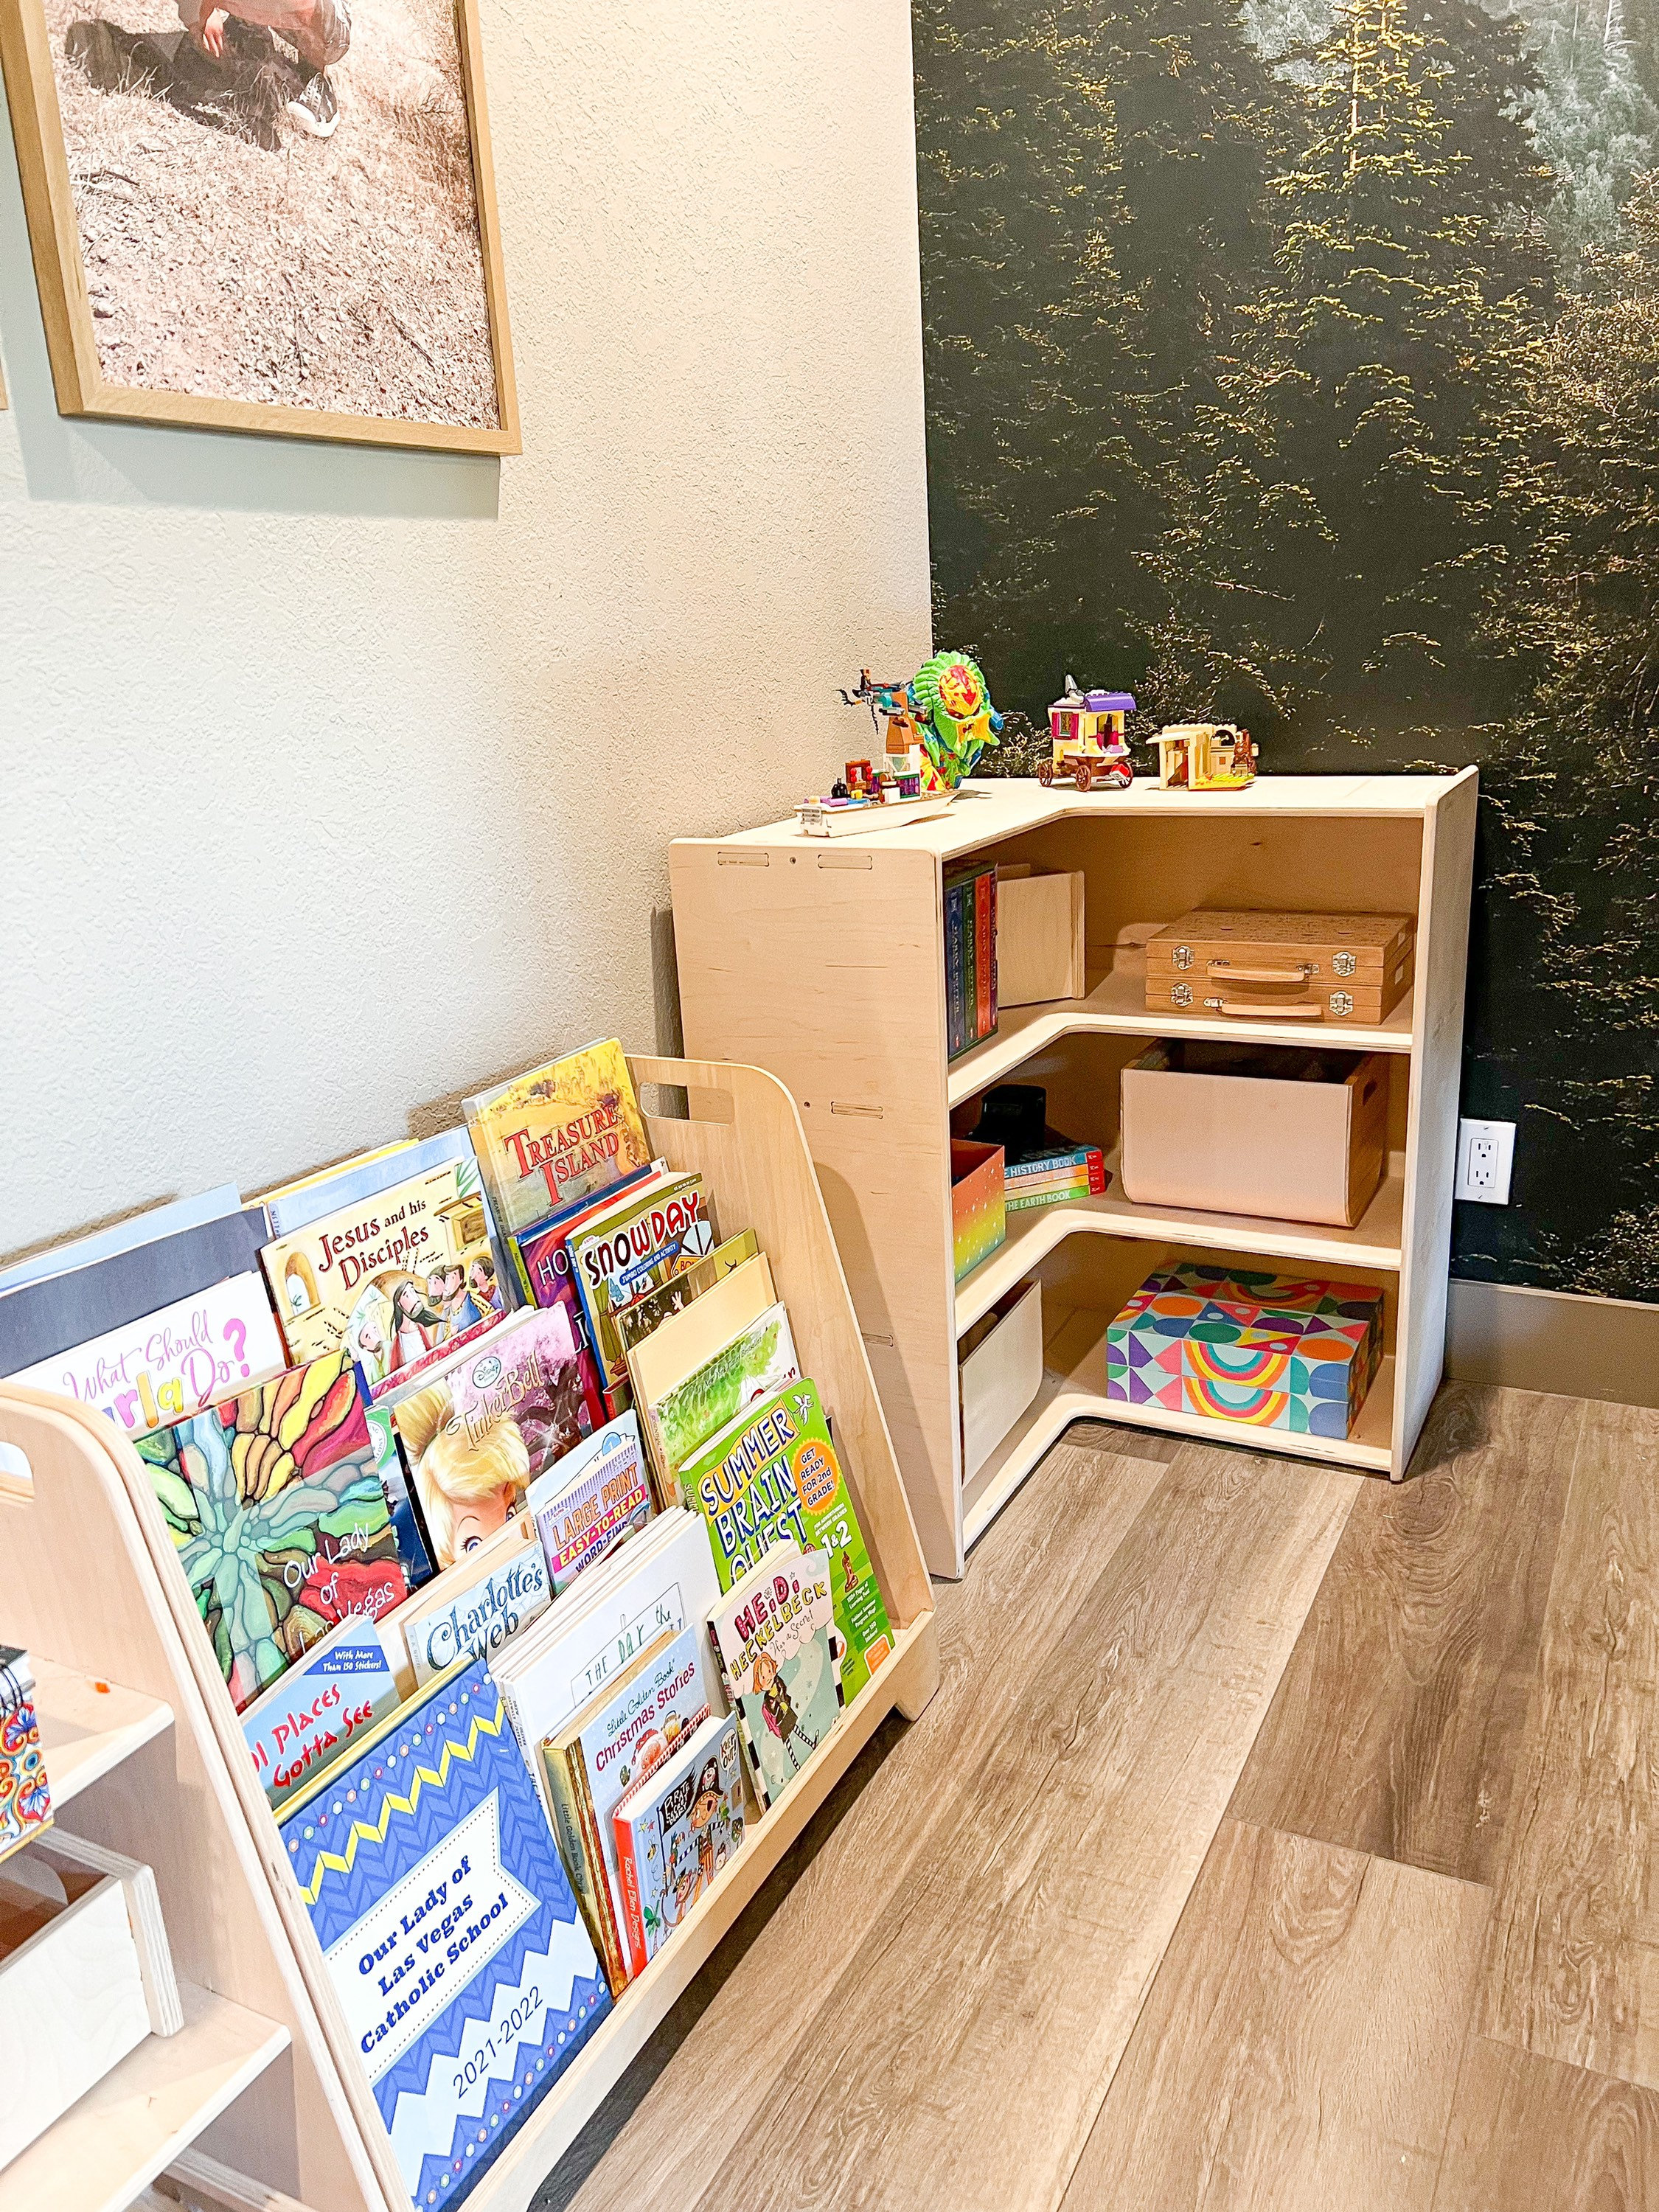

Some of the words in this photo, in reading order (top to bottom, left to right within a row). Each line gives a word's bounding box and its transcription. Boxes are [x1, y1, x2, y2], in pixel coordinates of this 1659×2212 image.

[504, 1104, 619, 1179] TREASURE
[539, 1132, 619, 1207] ISLAND
[1010, 1161, 1051, 1177] HISTORY
[1051, 1156, 1077, 1169] BOOK
[650, 1192, 698, 1244] DAY
[1020, 1196, 1046, 1209] EARTH
[1047, 1190, 1071, 1201] BOOK
[319, 1217, 380, 1273] Jesus
[384, 1206, 406, 1228] and
[408, 1199, 426, 1216] his
[338, 1225, 429, 1291] Disciples
[63, 1348, 142, 1402] What
[145, 1310, 213, 1371] Should
[102, 1370, 184, 1429] rla
[700, 1407, 796, 1516] SUMMER
[800, 1456, 825, 1481] READY
[801, 1447, 815, 1464] GET
[801, 1481, 818, 1495] FOR
[818, 1468, 832, 1483] 2nd
[552, 1493, 601, 1551] LARGE
[600, 1461, 639, 1512] PRINT
[714, 1453, 799, 1559] BRAIN
[807, 1481, 835, 1506] GRADE!
[284, 1551, 322, 1588] Our
[324, 1523, 369, 1565] Lady
[559, 1489, 643, 1568] EASY-TO-READ
[320, 1571, 339, 1604] of
[426, 1562, 543, 1671] Charlotte's
[334, 1650, 354, 1660] With
[355, 1651, 374, 1659] More
[463, 1603, 519, 1661] Web
[585, 1655, 608, 1687] THE
[618, 1624, 644, 1664] DAY
[655, 1603, 671, 1625] the
[729, 1581, 827, 1681] HECKELBECK
[322, 1663, 341, 1672] Than
[342, 1662, 354, 1671] 150
[355, 1660, 382, 1671] Stickers!
[595, 1704, 655, 1772] Christmas
[656, 1661, 695, 1710] Stories
[606, 1710, 628, 1737] Little
[627, 1686, 655, 1715] Golden
[654, 1661, 675, 1688] Book
[560, 1802, 571, 1824] Little
[565, 1825, 577, 1851] Golden
[571, 1851, 580, 1869] Book
[623, 1857, 636, 1888] Rachel
[358, 1930, 398, 1976] Our
[399, 1881, 448, 1935] Lady
[451, 1854, 472, 1885] of
[627, 1888, 636, 1911] Ellen
[630, 1915, 642, 1949] Designs
[360, 1962, 445, 2054] Catholic
[446, 1892, 509, 1966] School
[378, 1952, 416, 1997] Las
[415, 1893, 473, 1954] Vegas
[453, 1986, 543, 2100] 2021-2022
